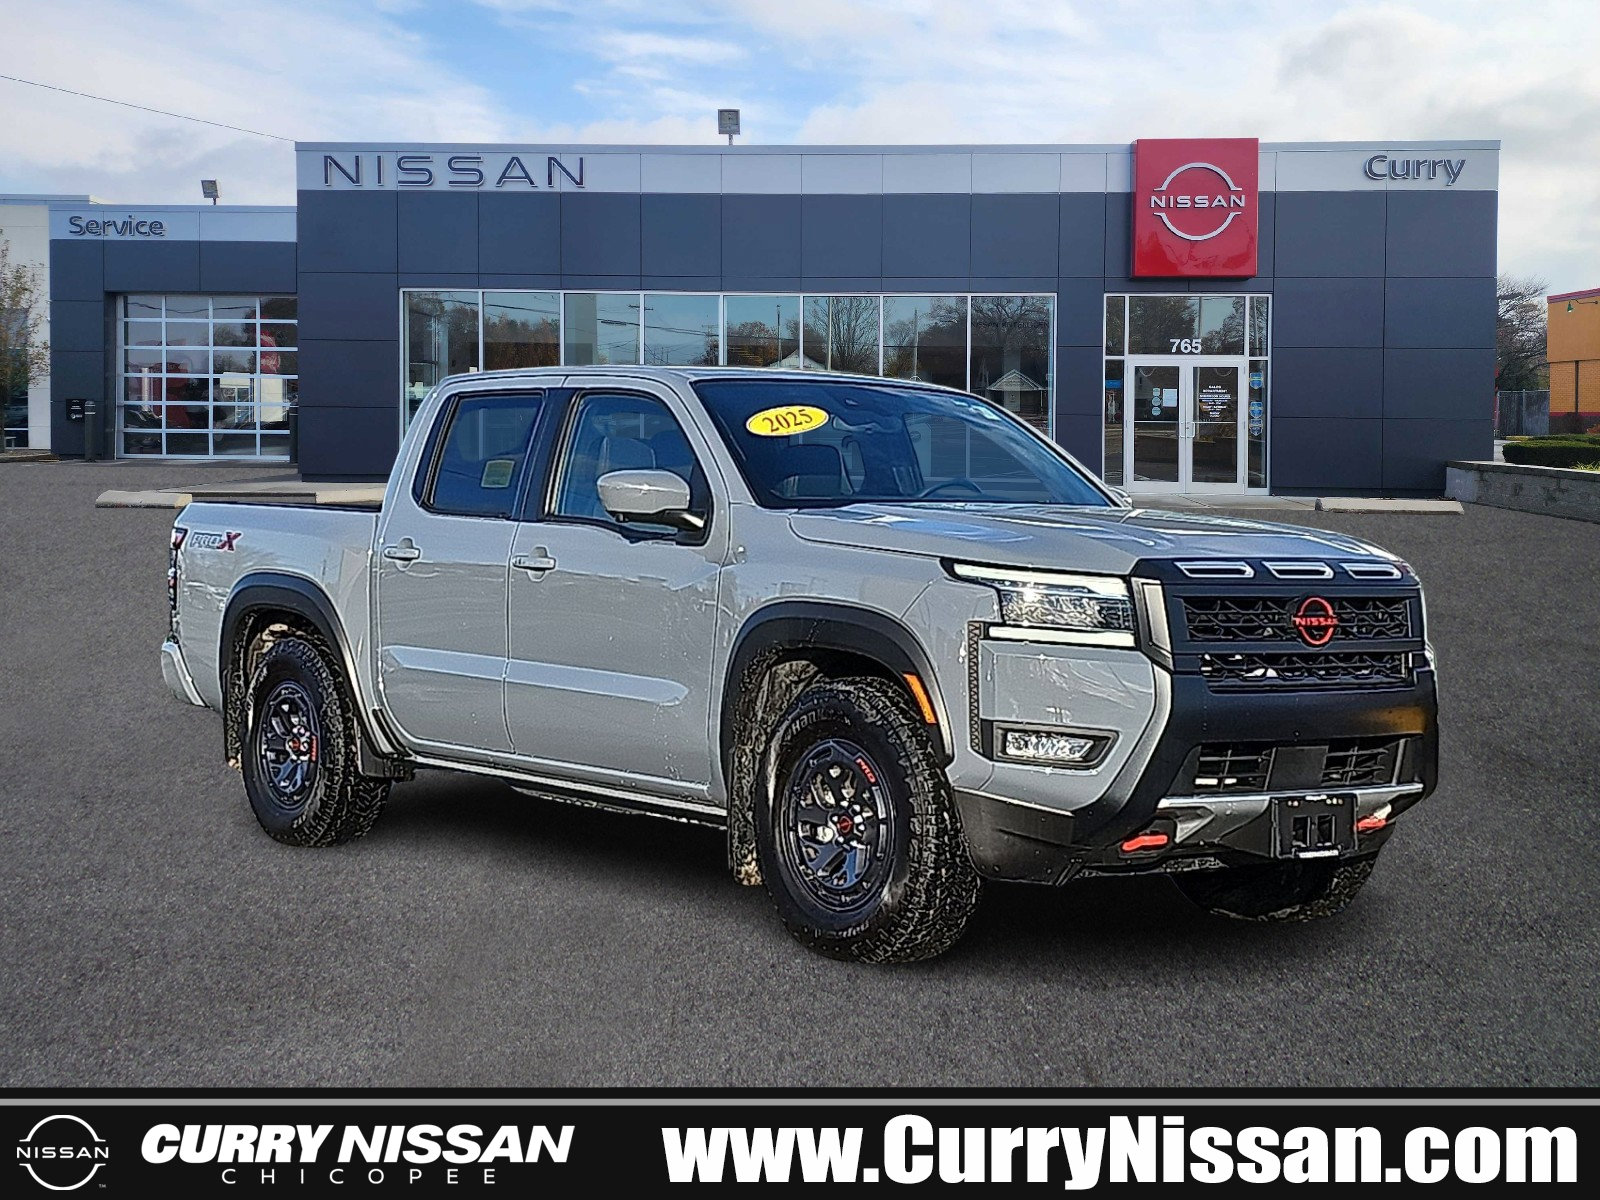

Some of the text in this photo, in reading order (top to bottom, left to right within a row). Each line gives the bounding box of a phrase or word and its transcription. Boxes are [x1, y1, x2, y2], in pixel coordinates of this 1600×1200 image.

[324, 155, 586, 188] NISSAN
[1365, 154, 1467, 186] Curry
[1150, 194, 1246, 208] NISSAN
[68, 214, 165, 236] Service
[1169, 338, 1202, 354] 765
[762, 408, 813, 433] 2025
